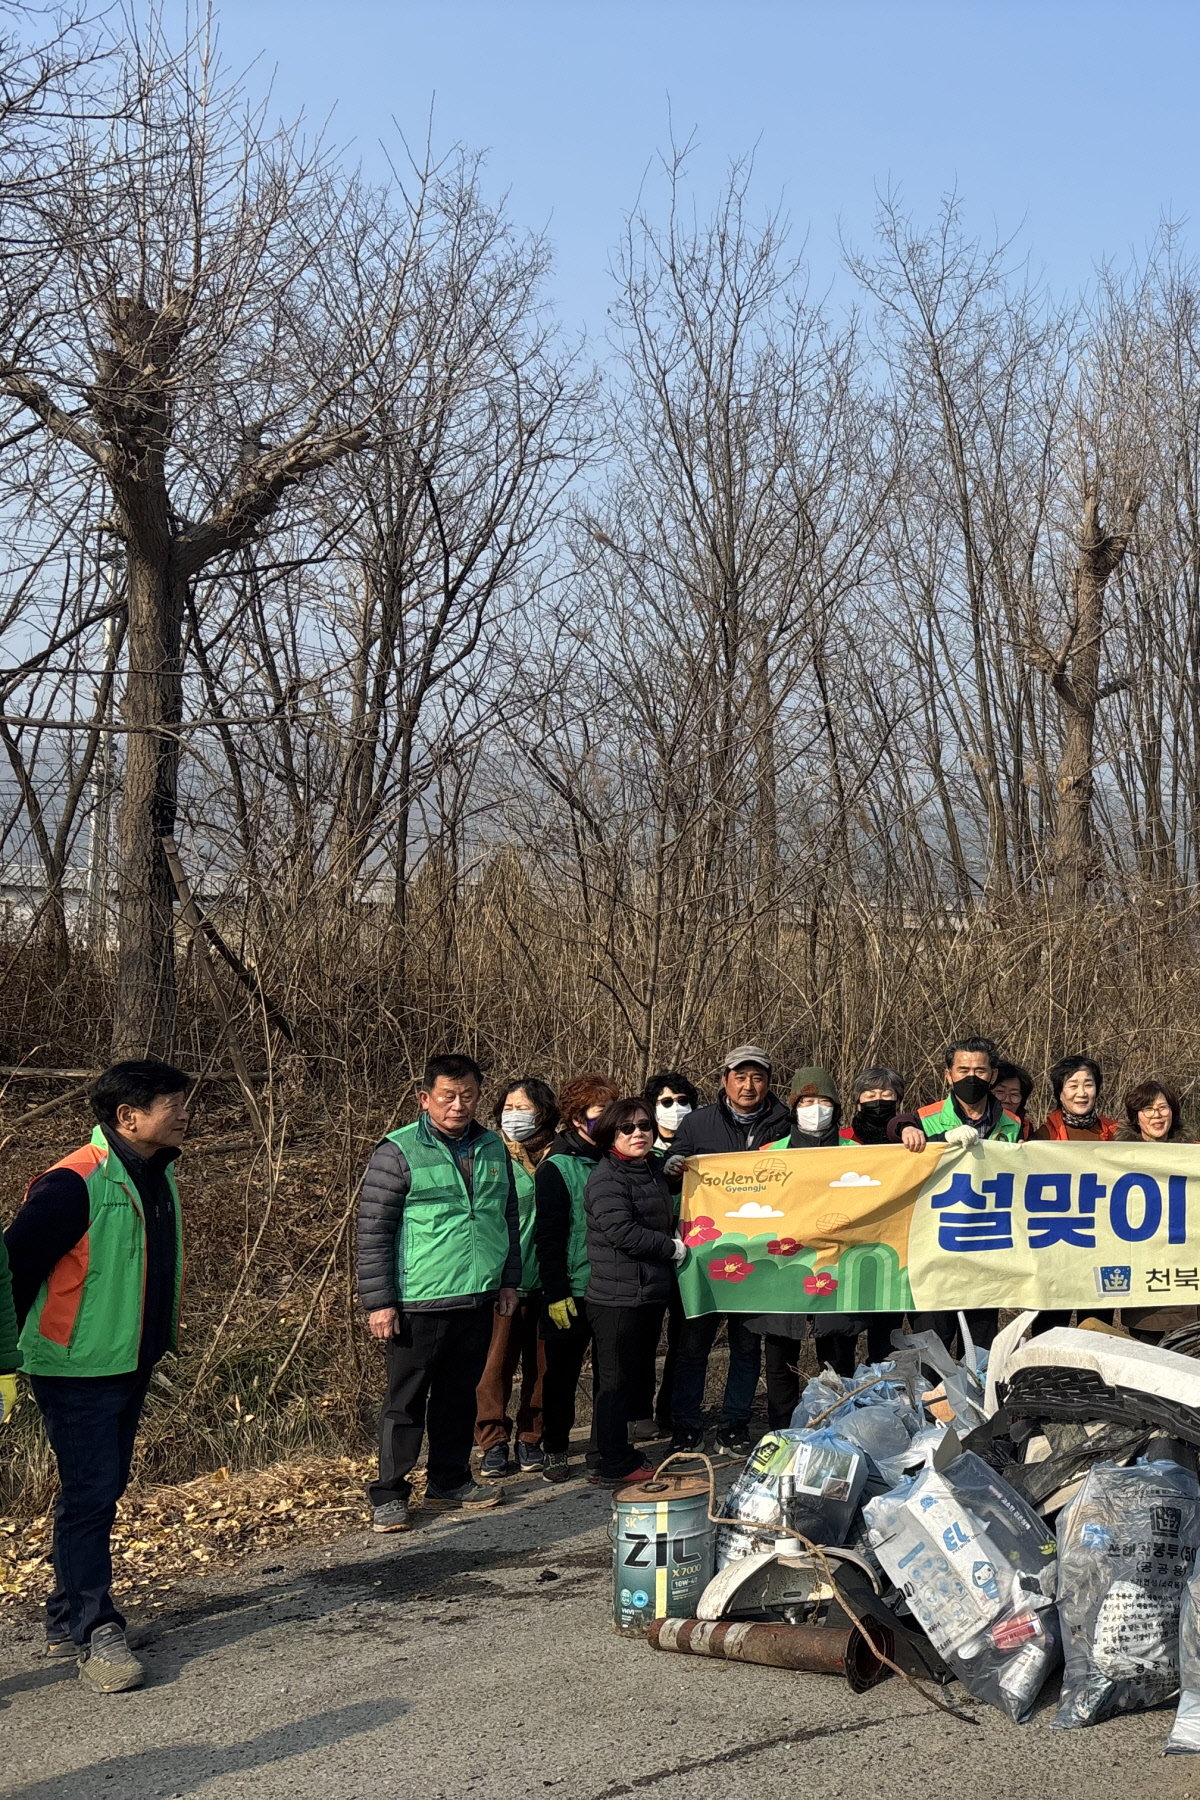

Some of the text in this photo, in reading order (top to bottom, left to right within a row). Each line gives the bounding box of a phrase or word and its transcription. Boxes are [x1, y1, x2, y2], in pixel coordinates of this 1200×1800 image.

[700, 1168, 793, 1187] Golden City
[725, 1184, 767, 1193] Gyeongju
[930, 1172, 1188, 1252] 설맞이
[624, 1516, 637, 1528] SK
[622, 1526, 703, 1569] ZIC
